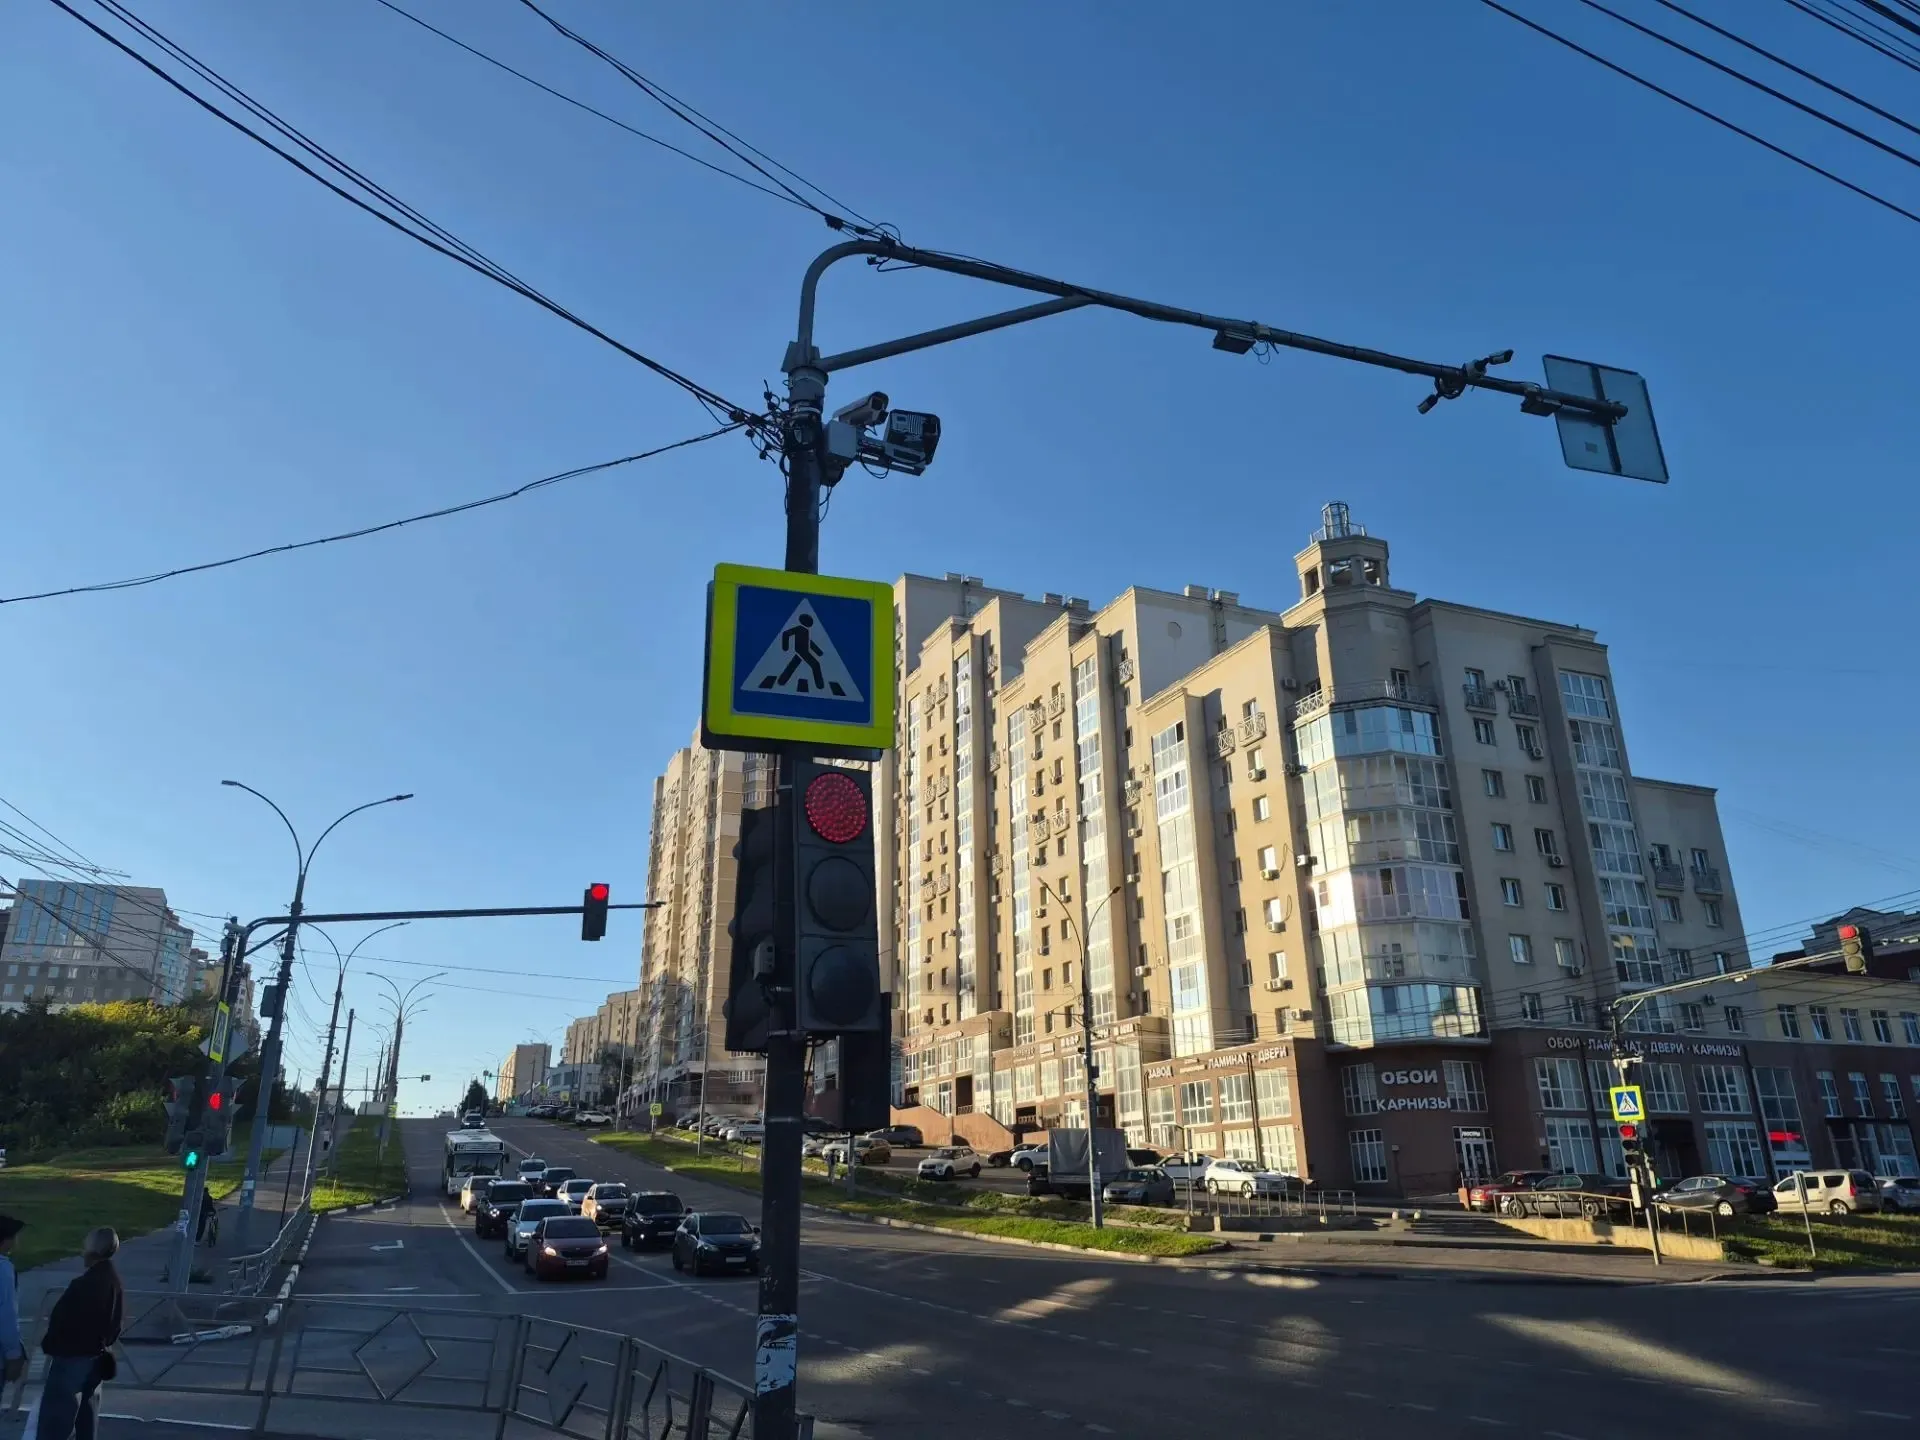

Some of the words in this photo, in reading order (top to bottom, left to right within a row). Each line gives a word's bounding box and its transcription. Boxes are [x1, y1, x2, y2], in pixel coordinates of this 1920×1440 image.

[1547, 1037, 1580, 1049] ОБОИ
[1588, 1038, 1642, 1052] ЛАМНАТ
[1650, 1041, 1684, 1055] ДВЕРИ
[1692, 1043, 1740, 1057] КАРНИЗЫ
[1207, 1053, 1247, 1069] ЛАМИНАТ
[1258, 1046, 1287, 1063] ДВЕРИ
[1381, 1070, 1438, 1084] ОБОИ
[1376, 1097, 1451, 1111] КАРНИЗЫ
